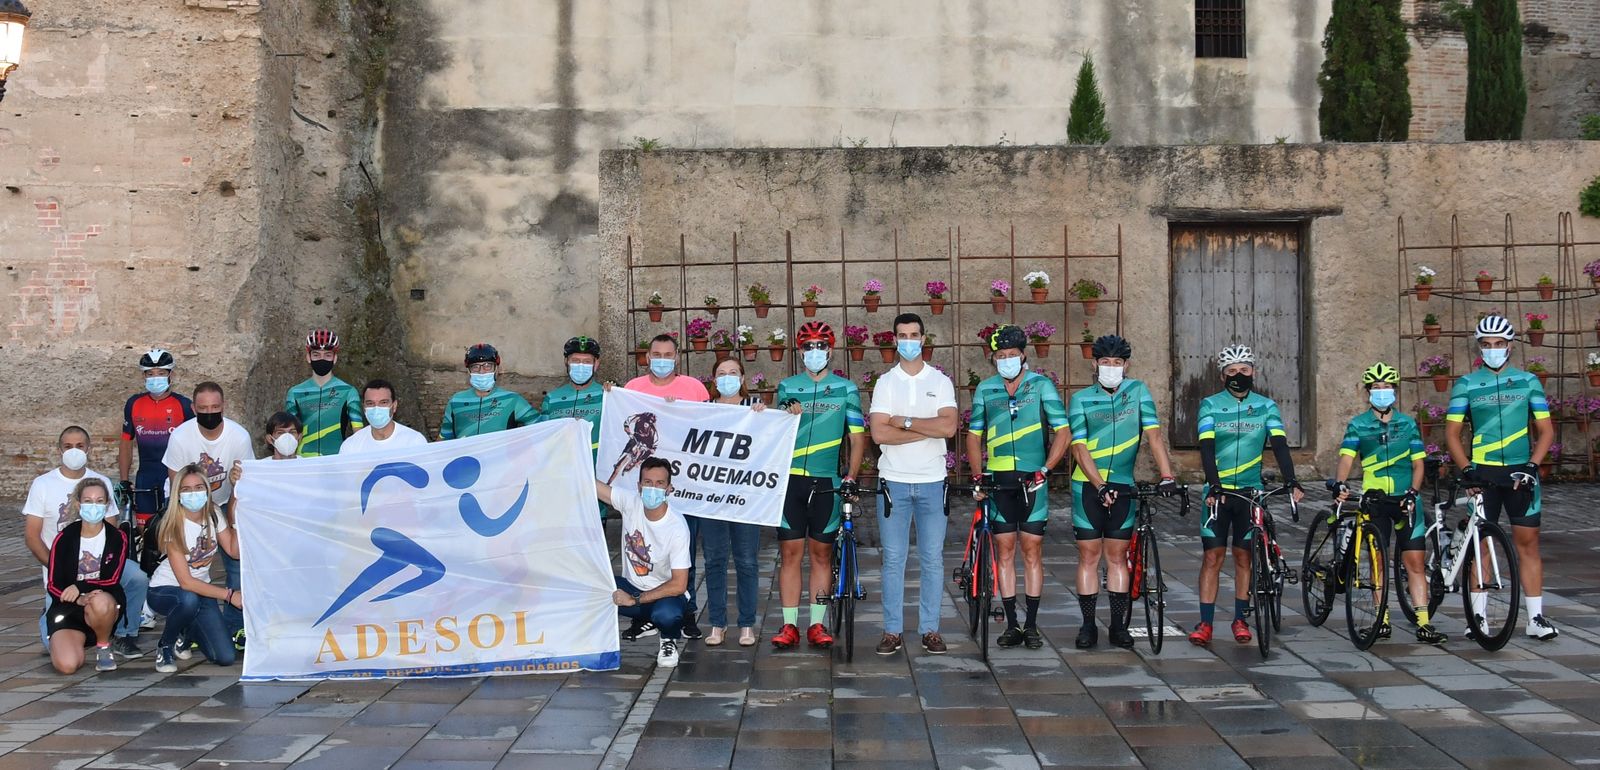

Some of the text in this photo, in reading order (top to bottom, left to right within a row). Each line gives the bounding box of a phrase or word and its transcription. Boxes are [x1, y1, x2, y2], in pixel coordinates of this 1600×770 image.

[681, 428, 752, 460] MTB
[687, 462, 779, 489] QUEMAOS
[706, 492, 725, 503] del
[726, 494, 746, 506] Río
[313, 610, 544, 664] ADESOL
